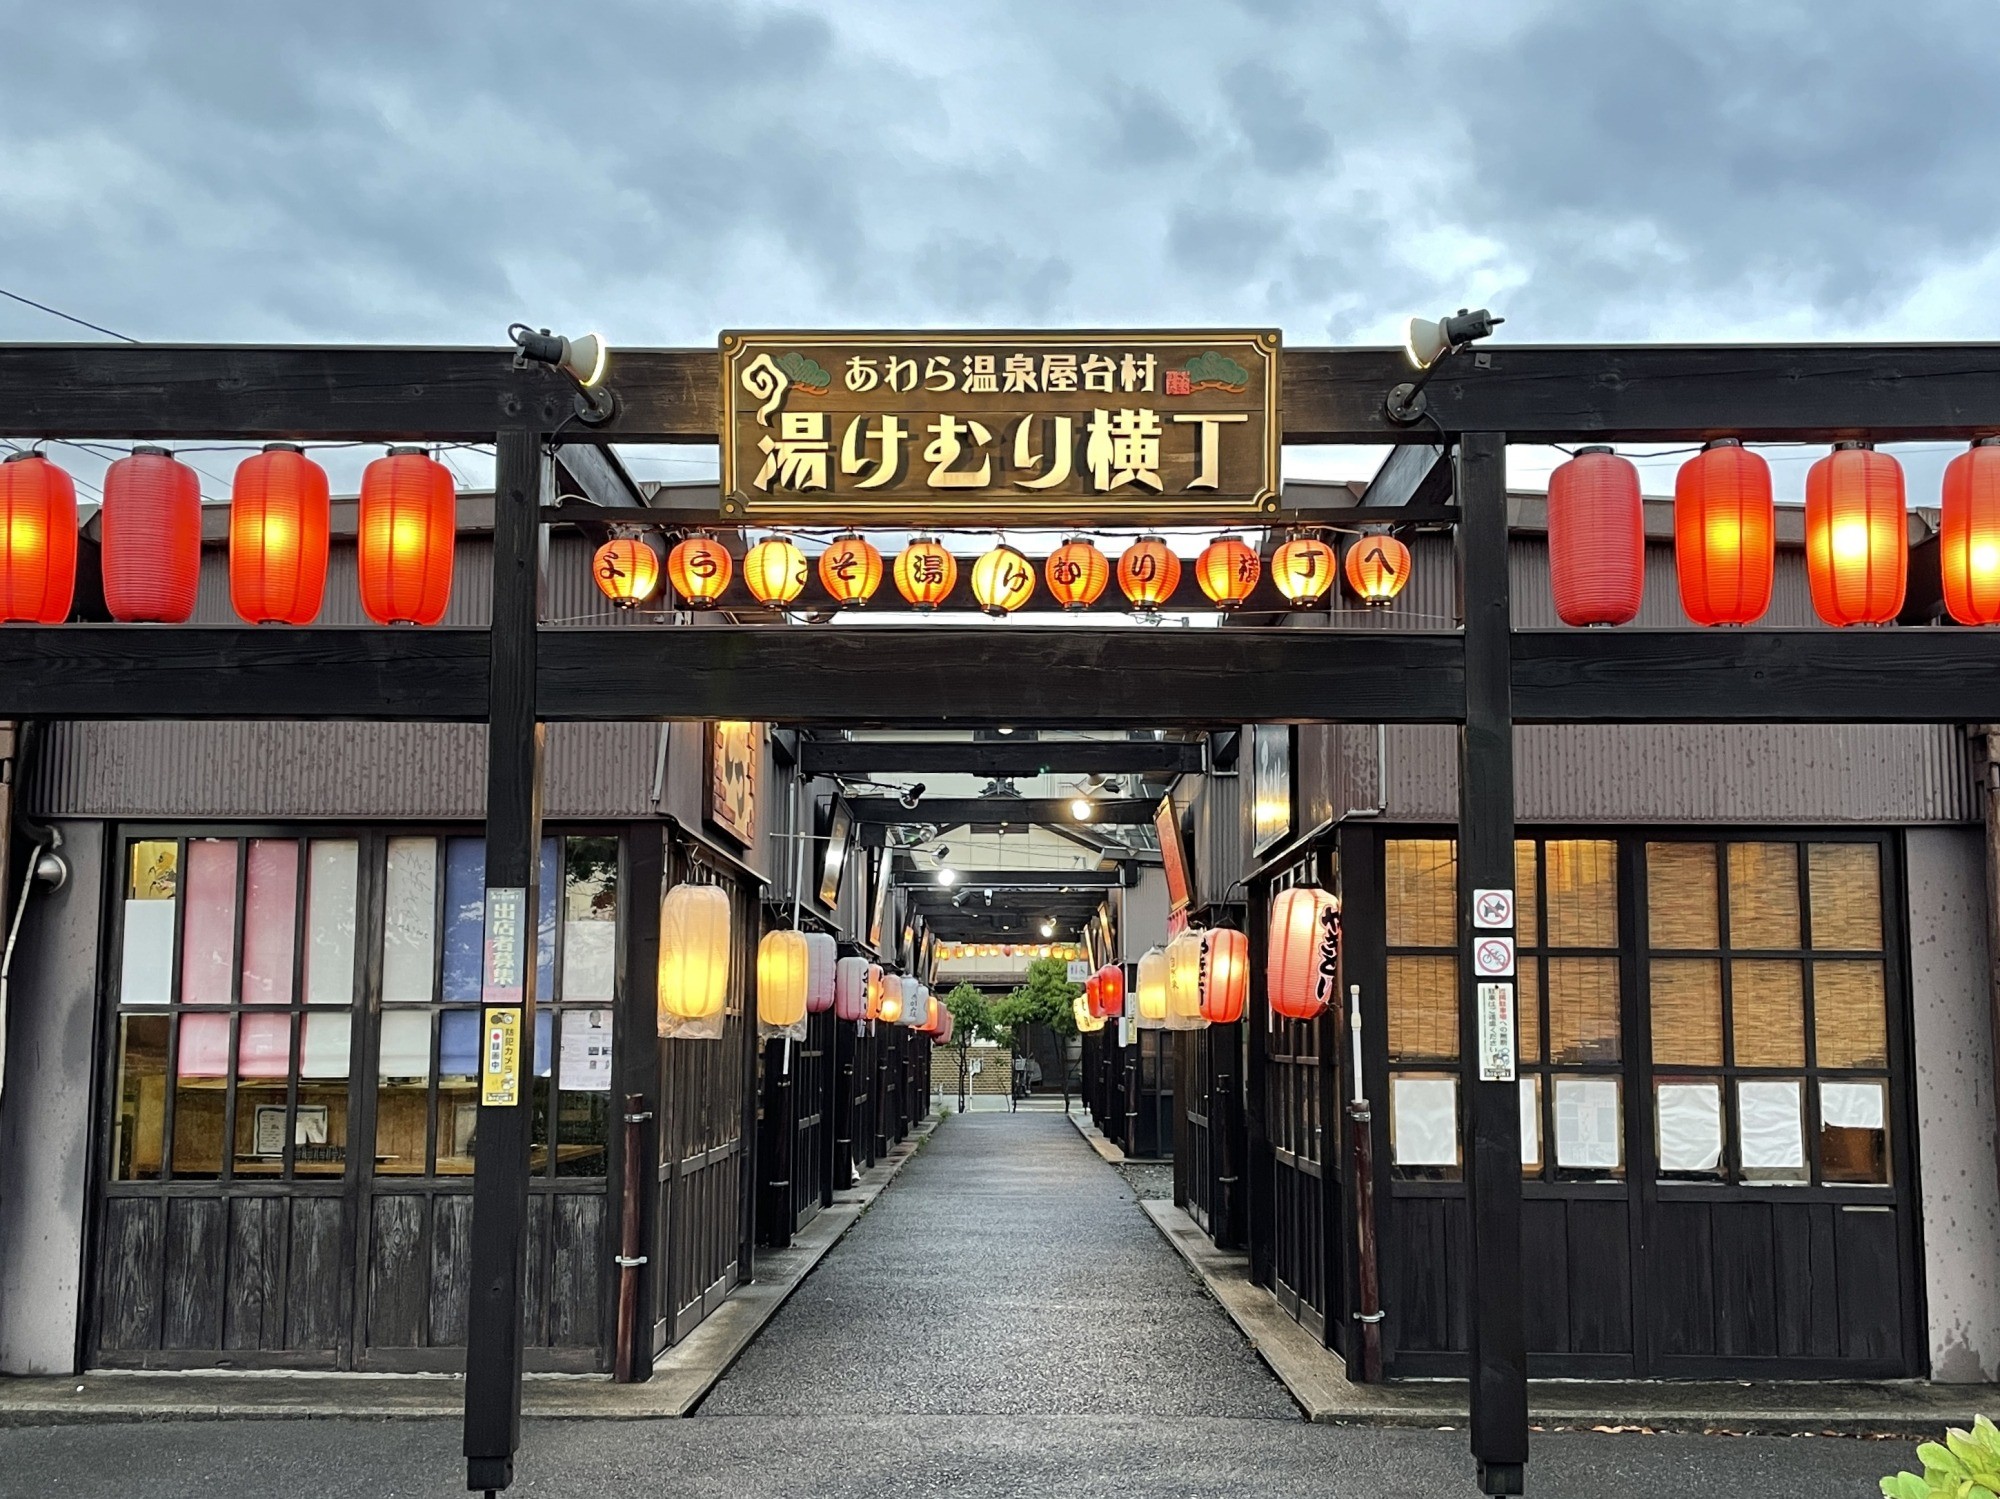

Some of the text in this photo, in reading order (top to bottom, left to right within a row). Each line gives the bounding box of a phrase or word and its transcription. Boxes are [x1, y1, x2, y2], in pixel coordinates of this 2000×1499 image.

[845, 353, 1157, 394] あわら温泉屋台村
[754, 407, 1249, 492] 湯けむり横丁
[492, 902, 516, 985] 出店者募集
[504, 1028, 514, 1074] 防犯カメラ
